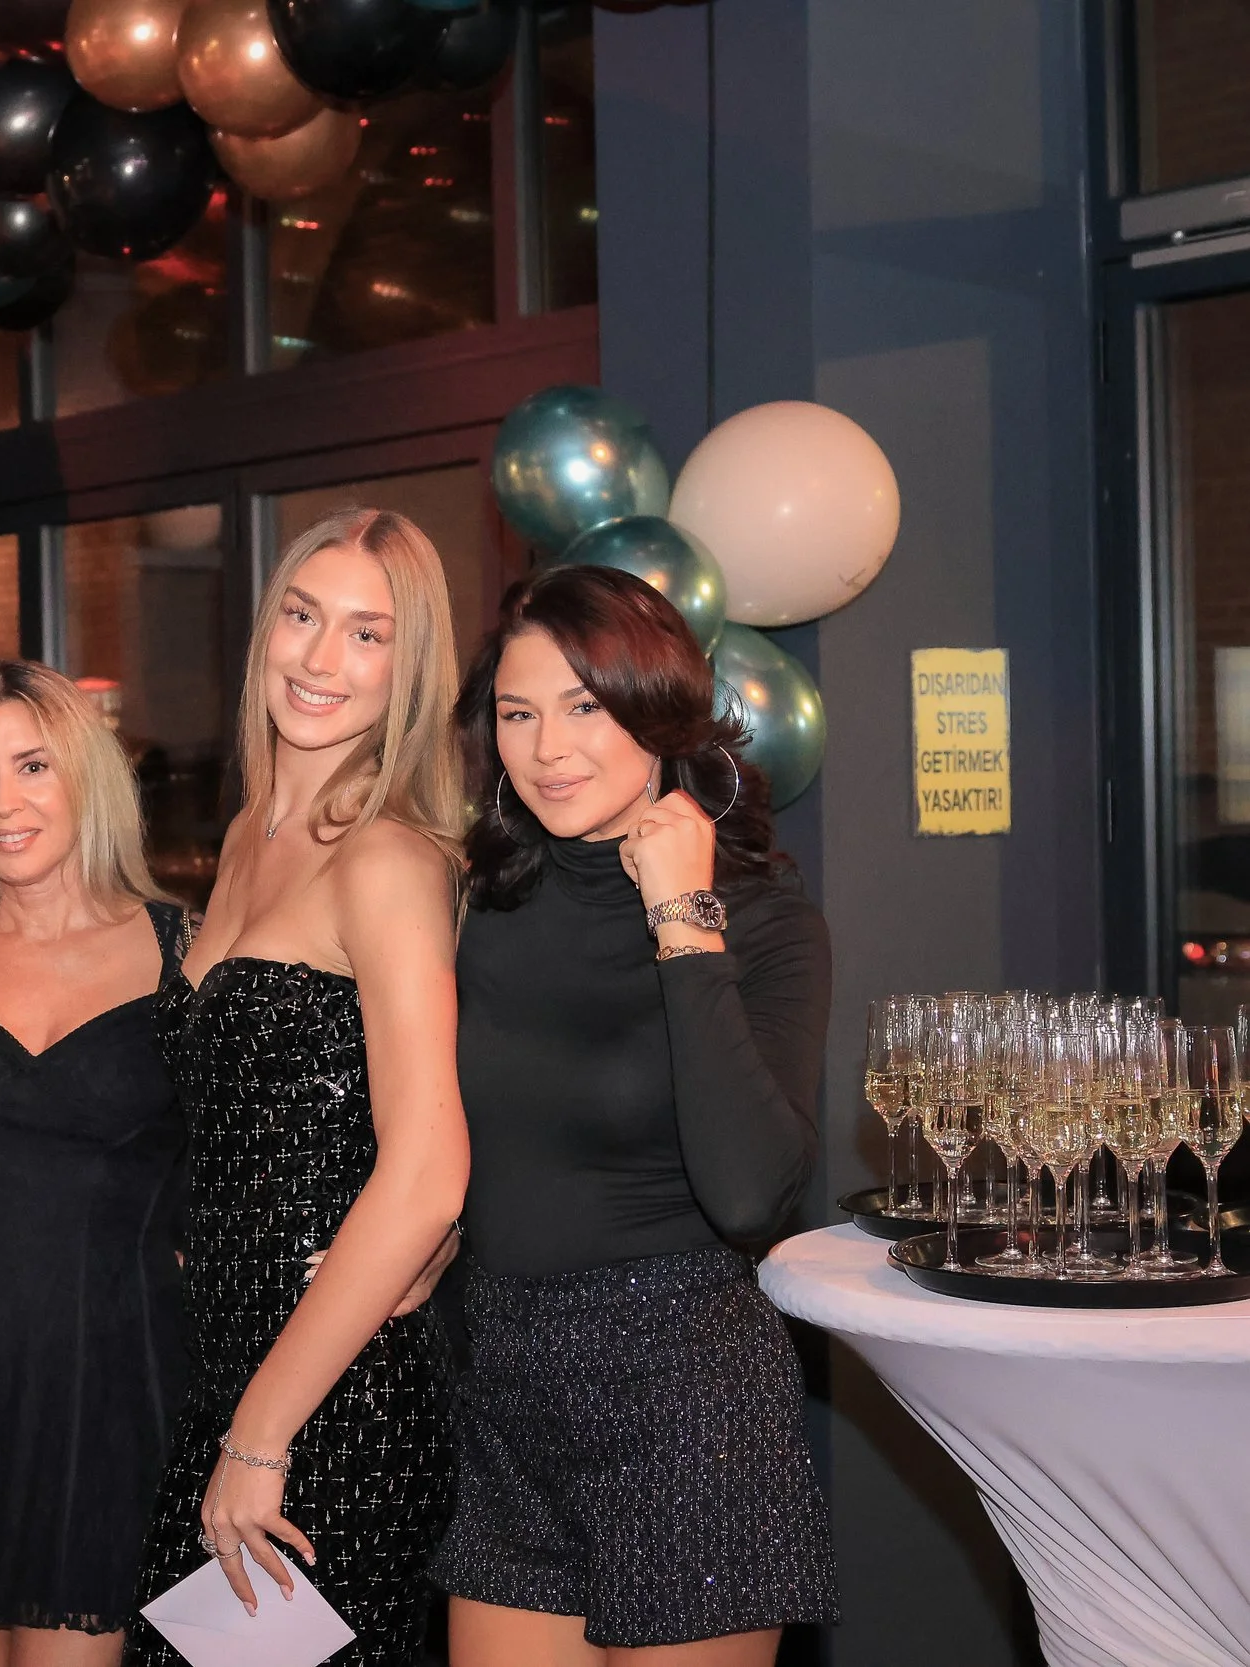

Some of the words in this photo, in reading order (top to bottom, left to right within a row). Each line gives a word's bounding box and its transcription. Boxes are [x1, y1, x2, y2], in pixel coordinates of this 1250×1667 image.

[918, 672, 1005, 699] DIŞARIDAN
[937, 711, 988, 734] STRES
[921, 745, 1004, 773] GETİRMEK
[922, 788, 1003, 812] YASAKTIR!
